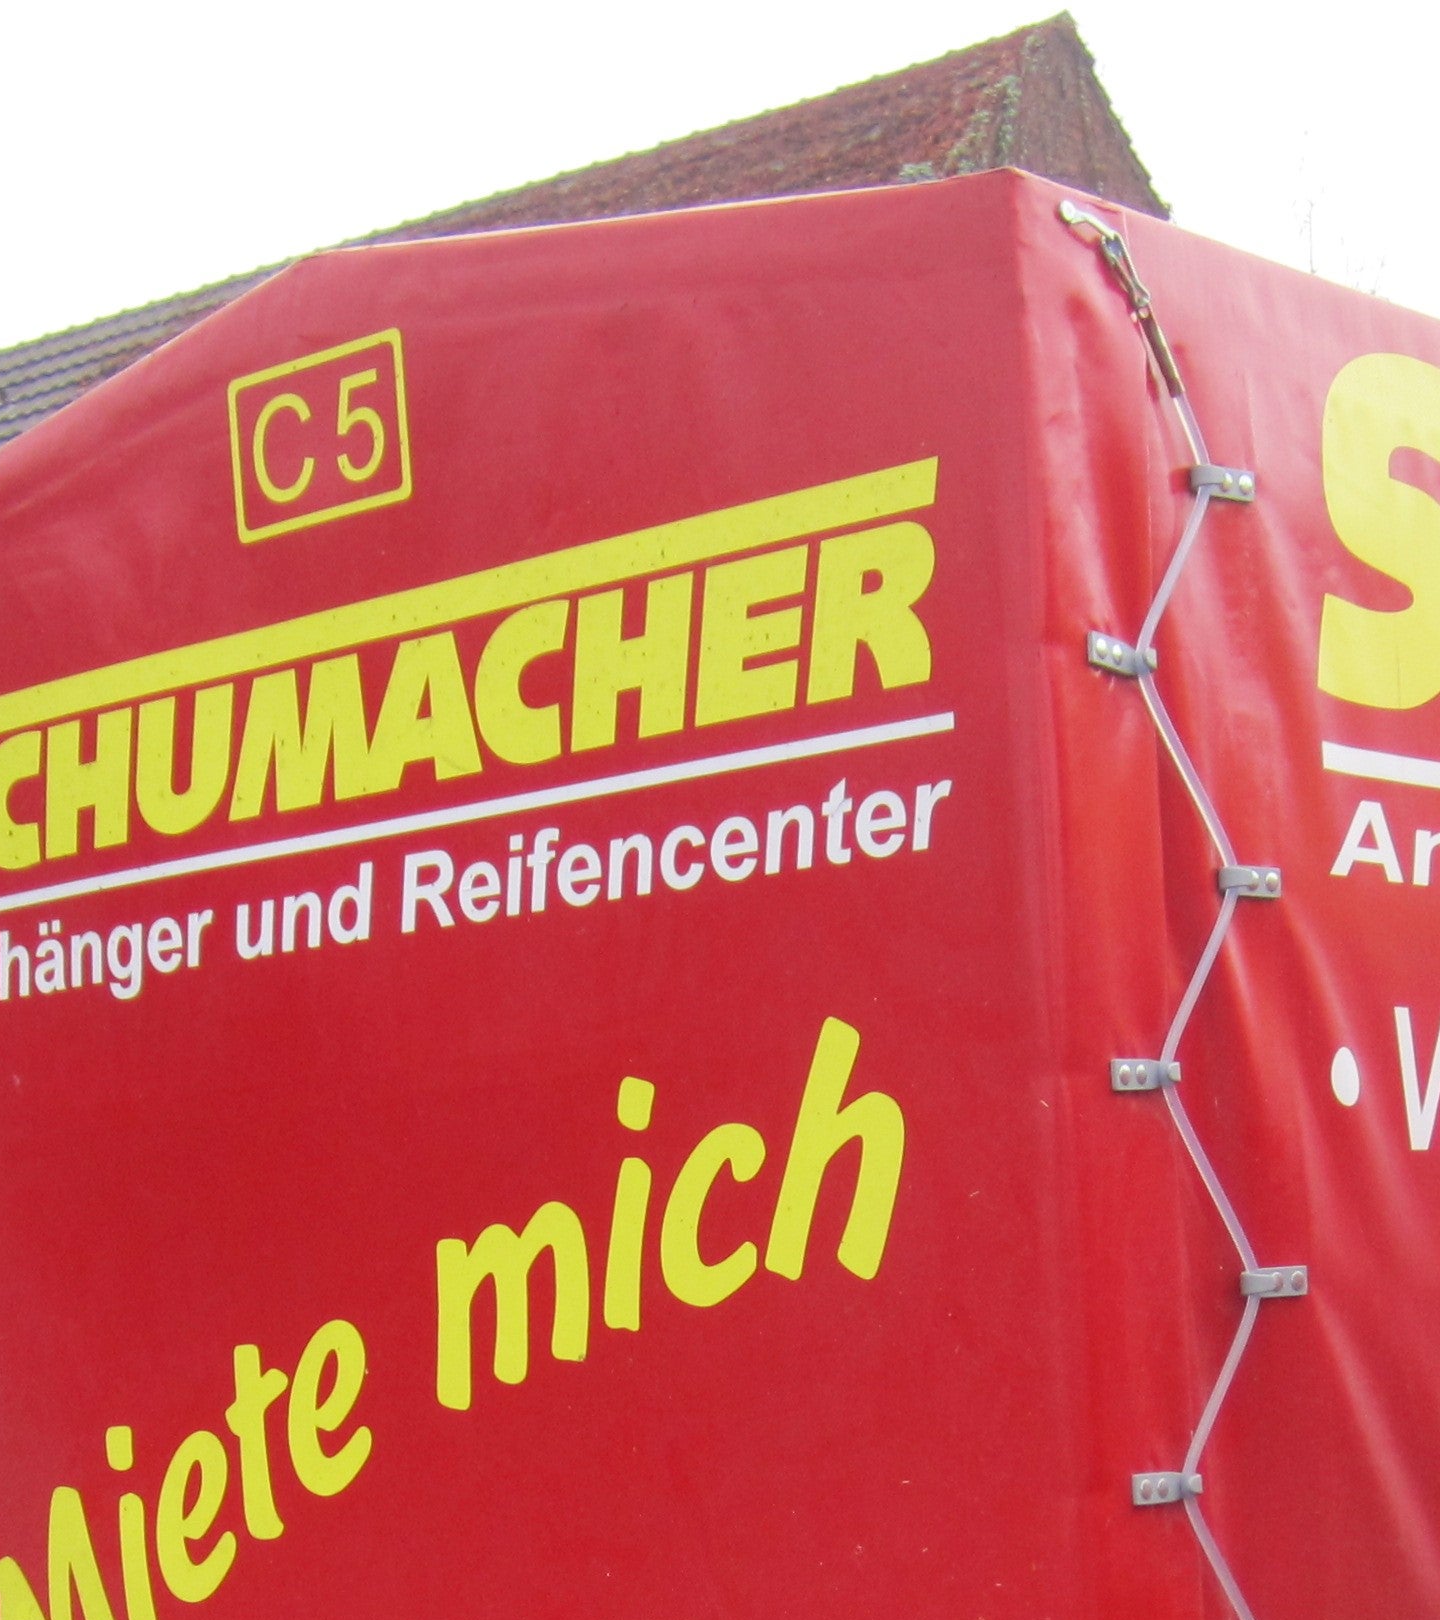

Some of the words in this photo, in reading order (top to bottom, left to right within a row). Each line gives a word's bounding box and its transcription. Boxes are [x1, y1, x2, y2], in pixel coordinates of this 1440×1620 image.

[237, 862, 372, 958] und
[401, 777, 953, 934] Reifencenter
[437, 1017, 904, 1410] mich
